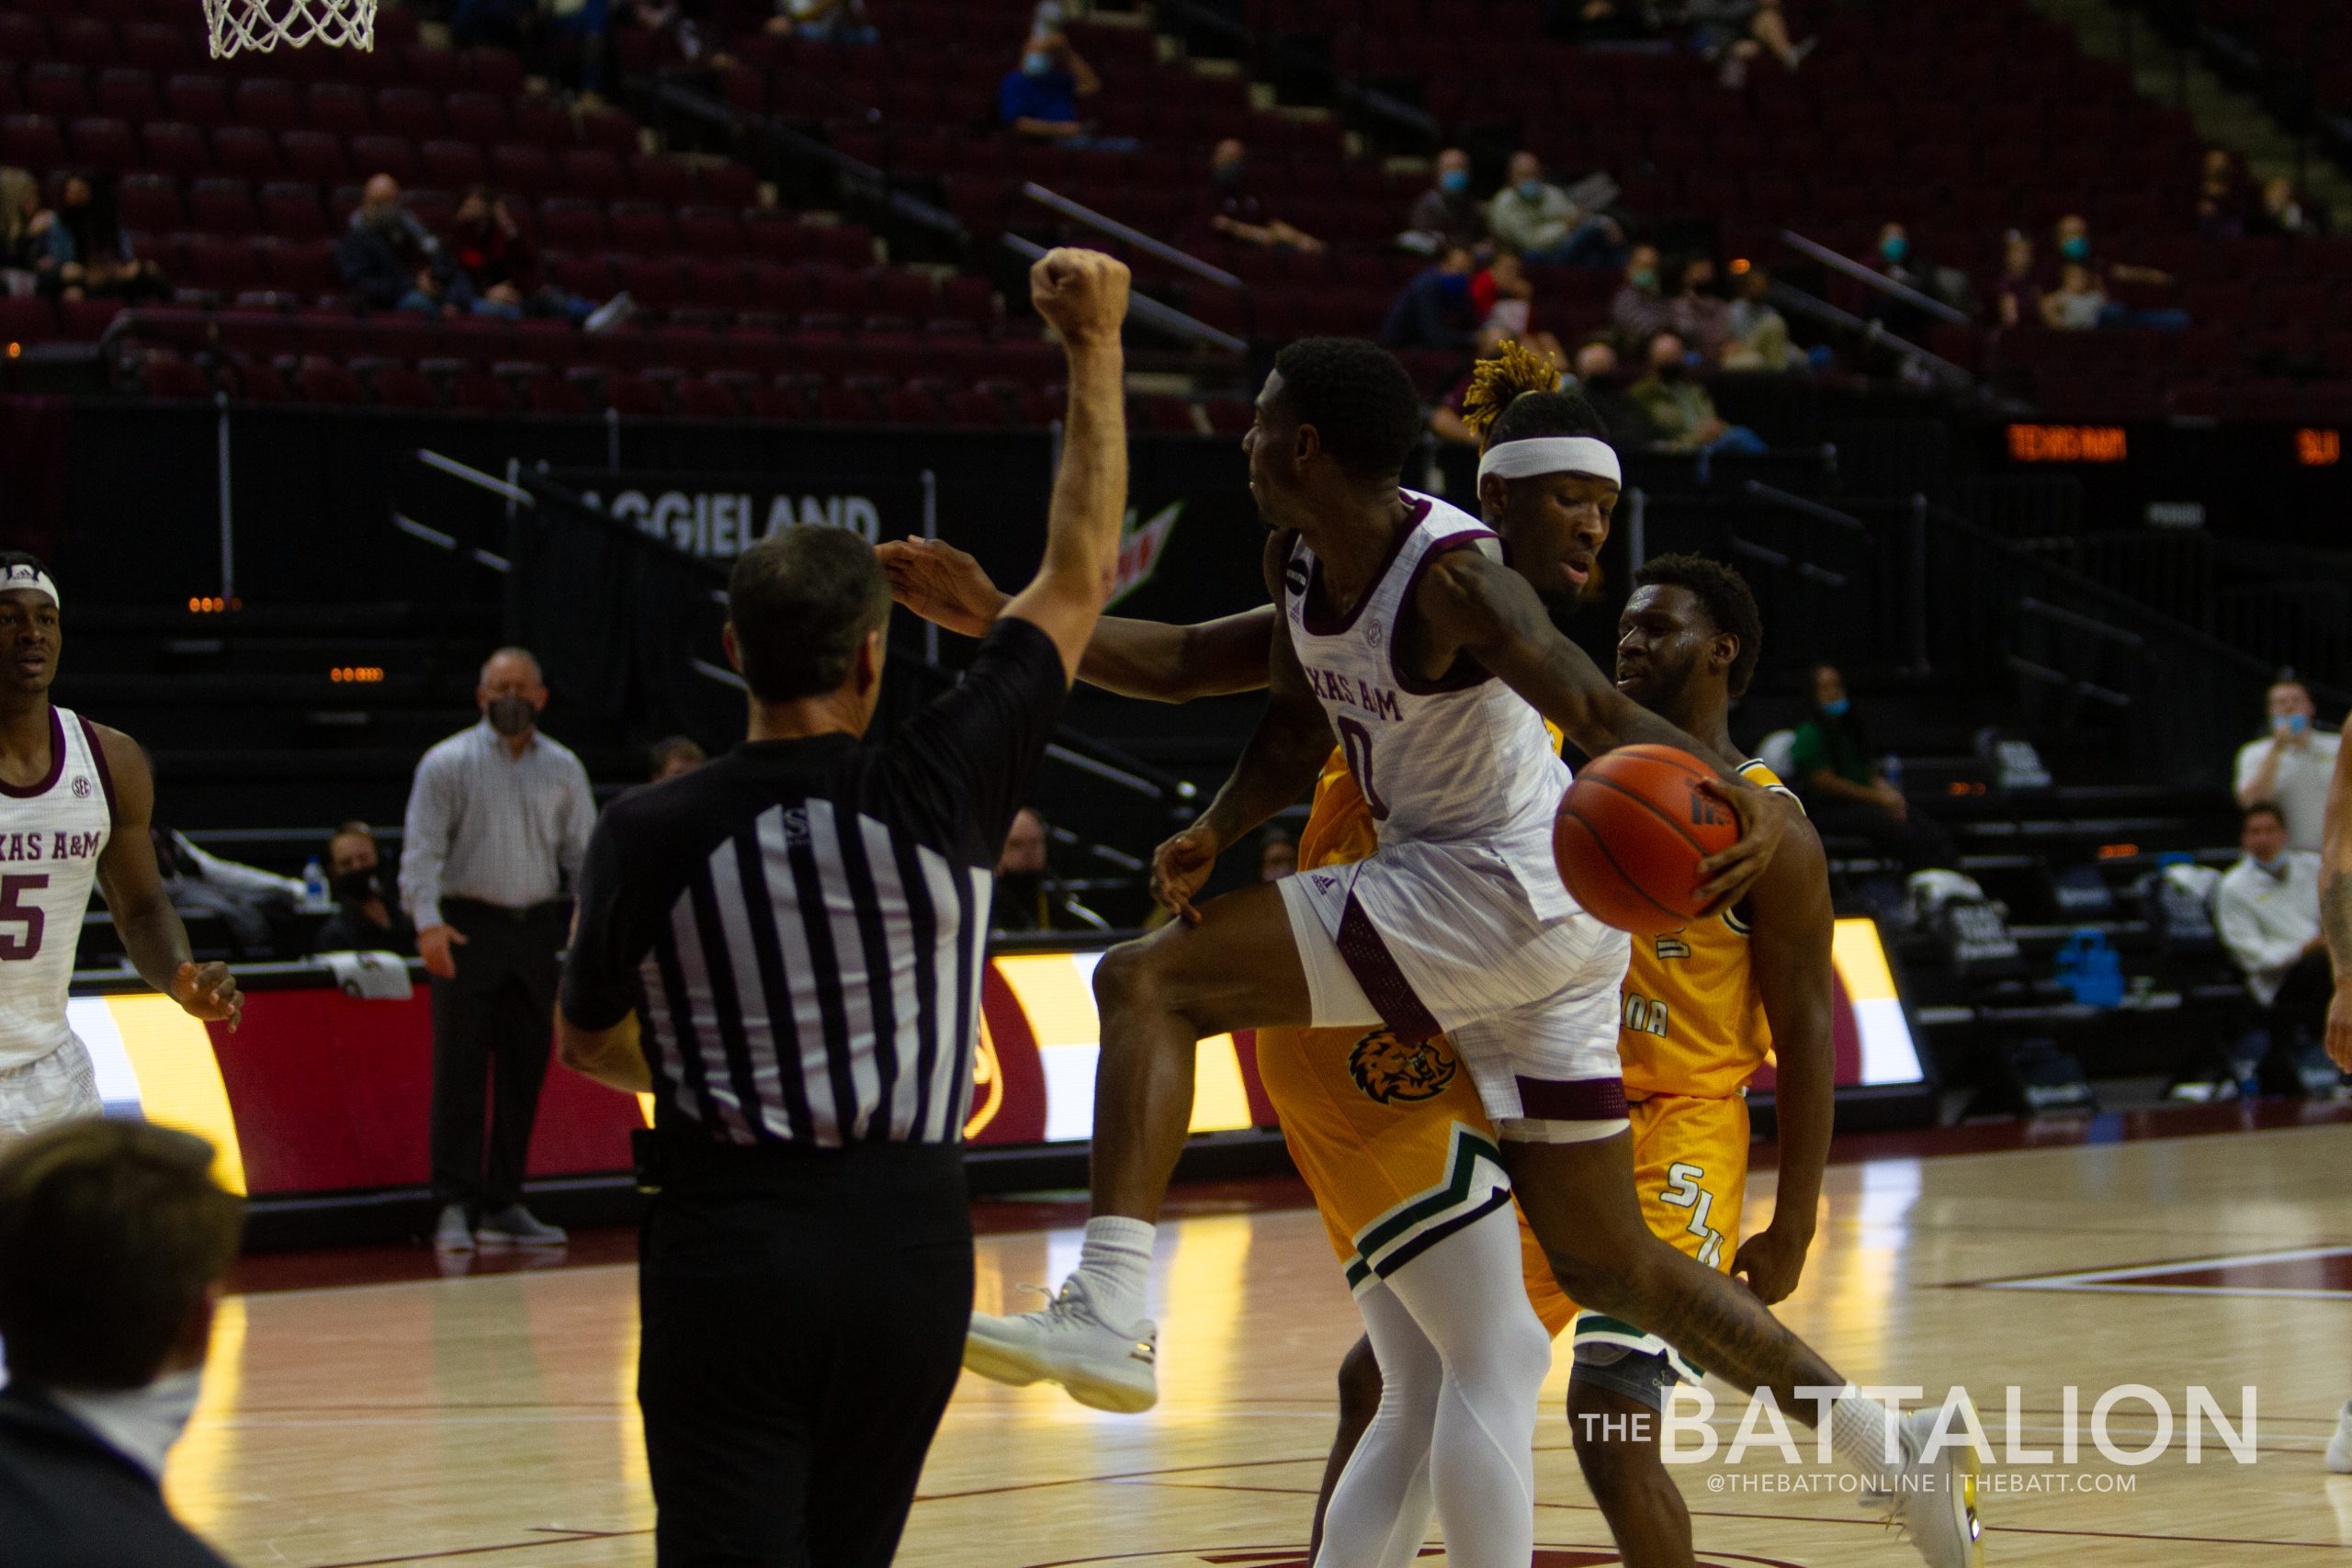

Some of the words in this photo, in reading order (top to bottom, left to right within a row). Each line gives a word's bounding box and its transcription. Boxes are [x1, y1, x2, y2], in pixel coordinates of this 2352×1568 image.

[1358, 678, 1403, 721] AM
[51, 831, 101, 859] A&M
[0, 874, 50, 961] 5
